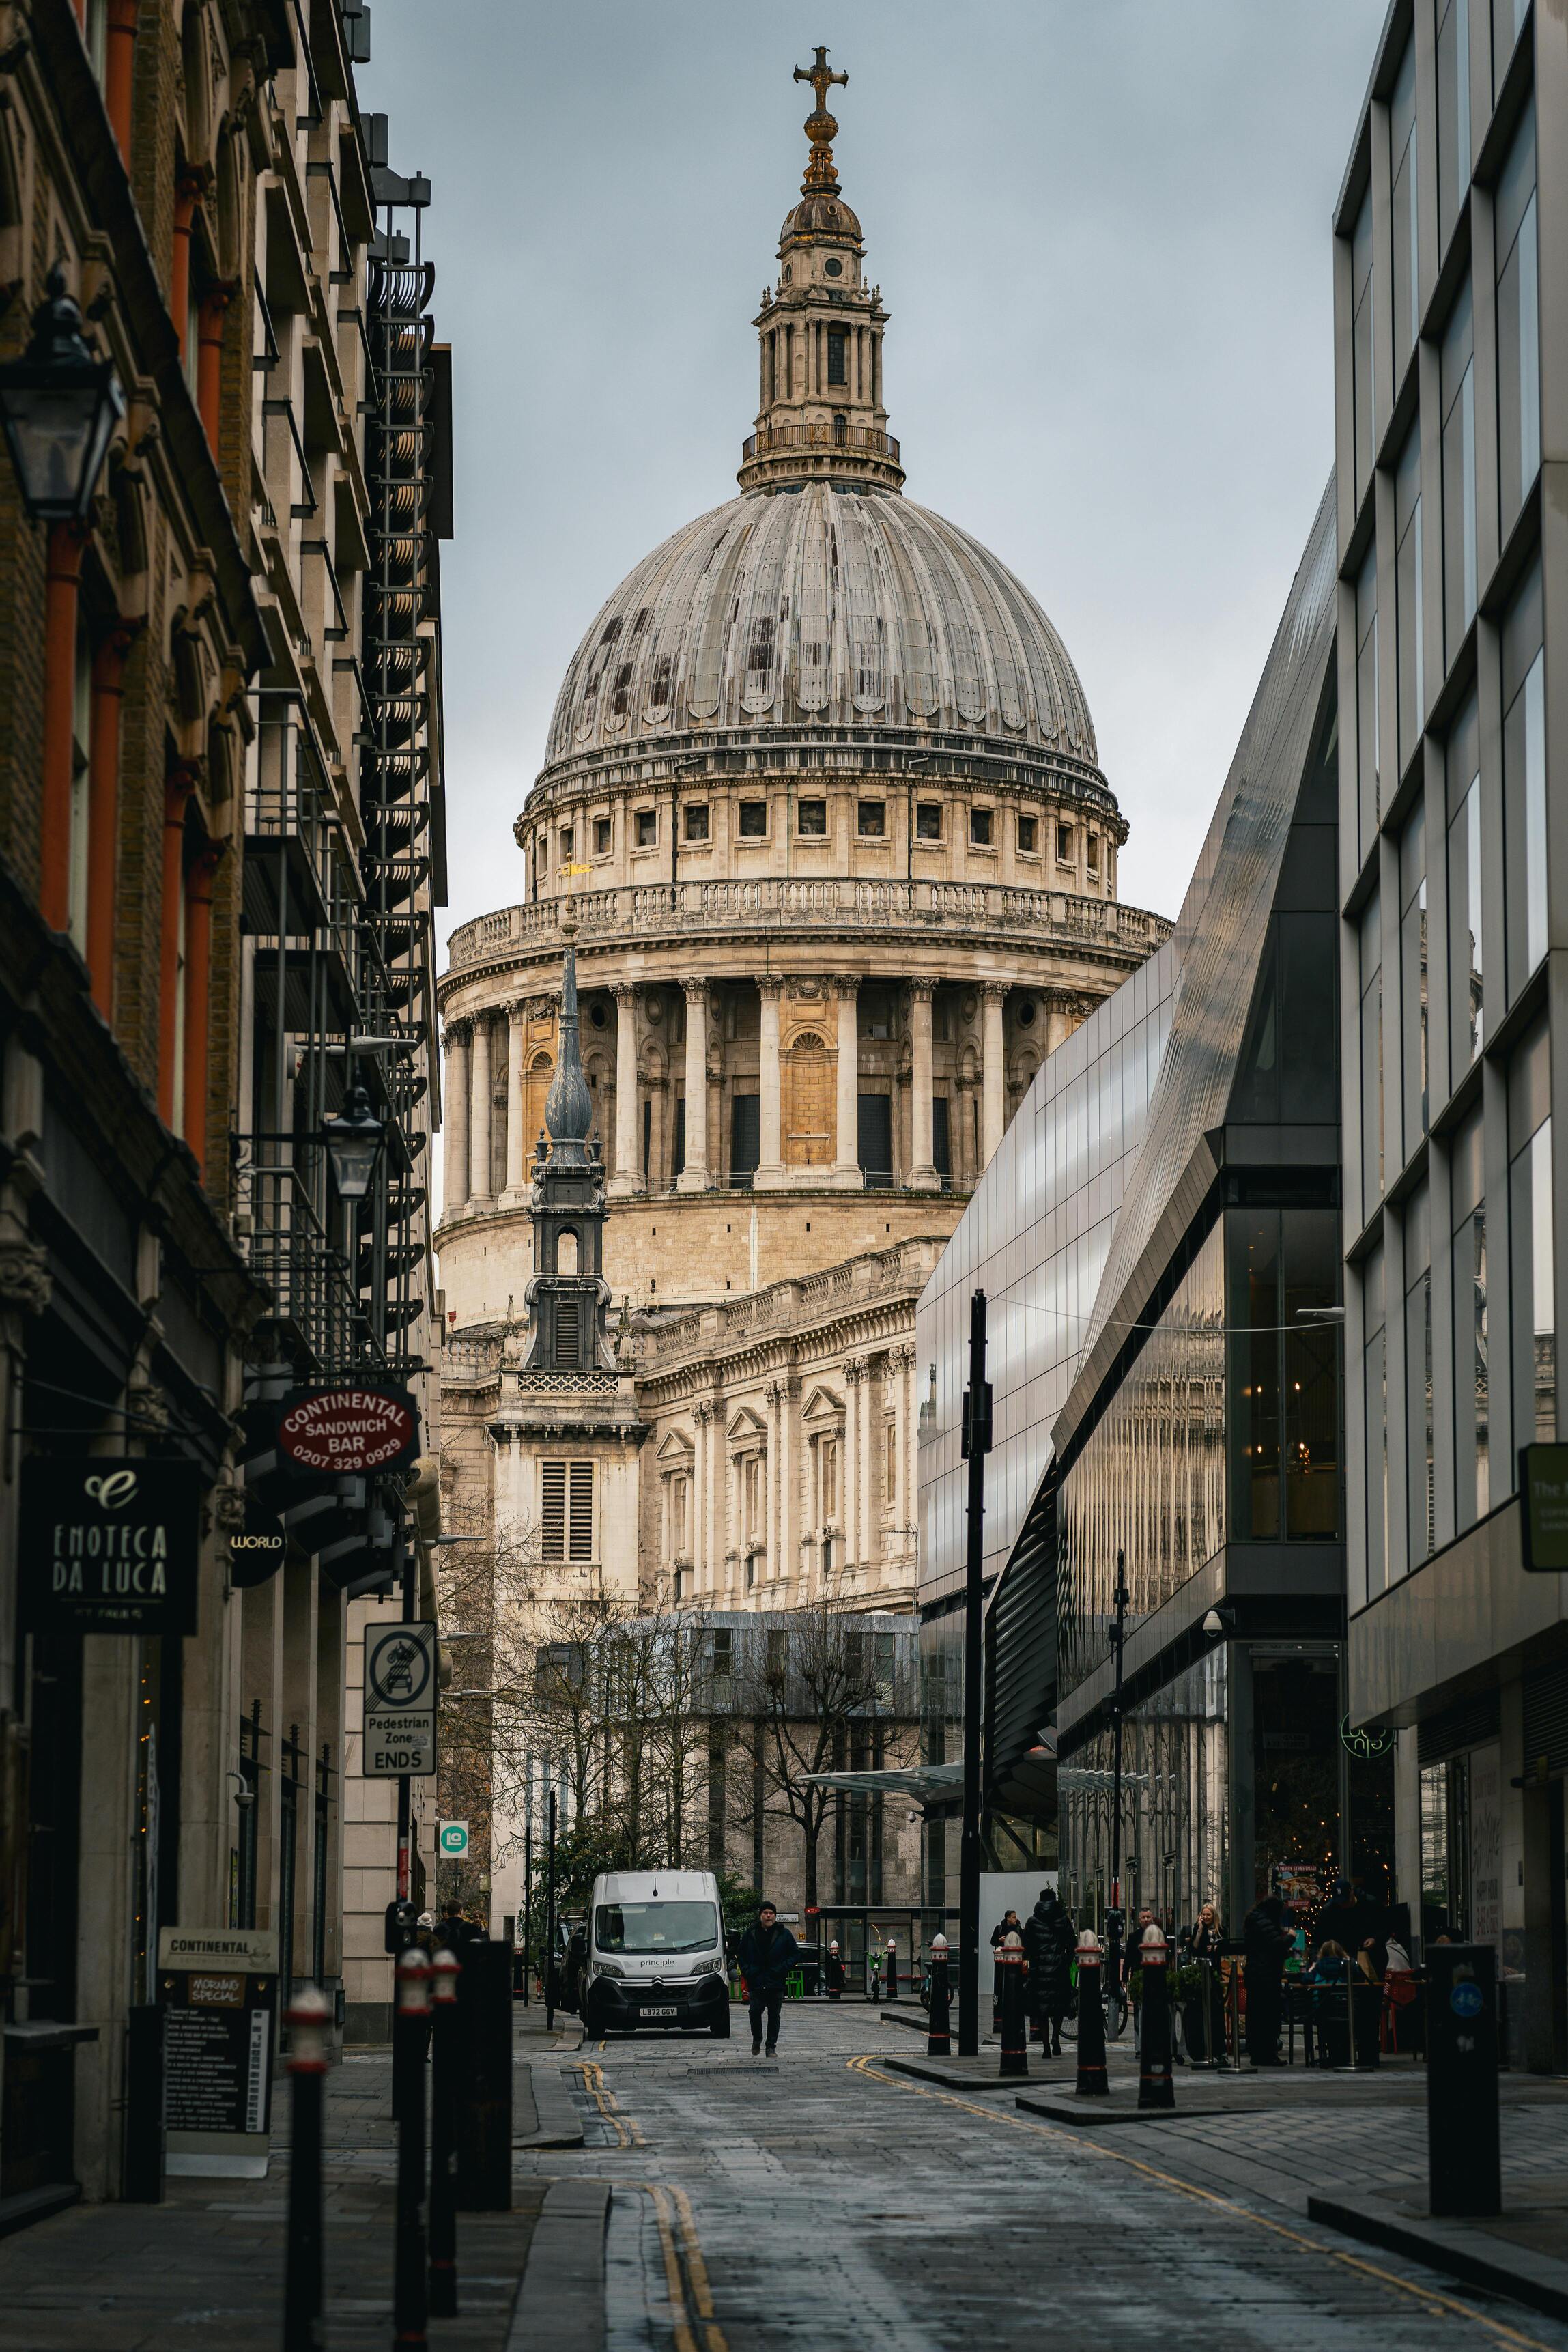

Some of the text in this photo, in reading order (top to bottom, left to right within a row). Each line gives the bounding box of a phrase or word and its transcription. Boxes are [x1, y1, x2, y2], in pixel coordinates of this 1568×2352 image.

[284, 1393, 405, 1433] CONTINENTAL
[304, 1418, 387, 1437] SANDWICH
[328, 1436, 365, 1454] BAR
[293, 1438, 401, 1470] 0207 329 0929
[53, 1524, 168, 1559] ENOTECA
[231, 1535, 283, 1549] WORLD
[52, 1560, 167, 1595] DA LUCA
[369, 1717, 429, 1729] Pedestrian
[385, 1733, 412, 1744] Zone
[375, 1751, 422, 1769] ENDS
[171, 1940, 249, 1954] CONTINENTAL
[640, 1959, 674, 1968] principle
[193, 1978, 240, 1991] MORNING
[192, 1989, 240, 2002] SPECIAL
